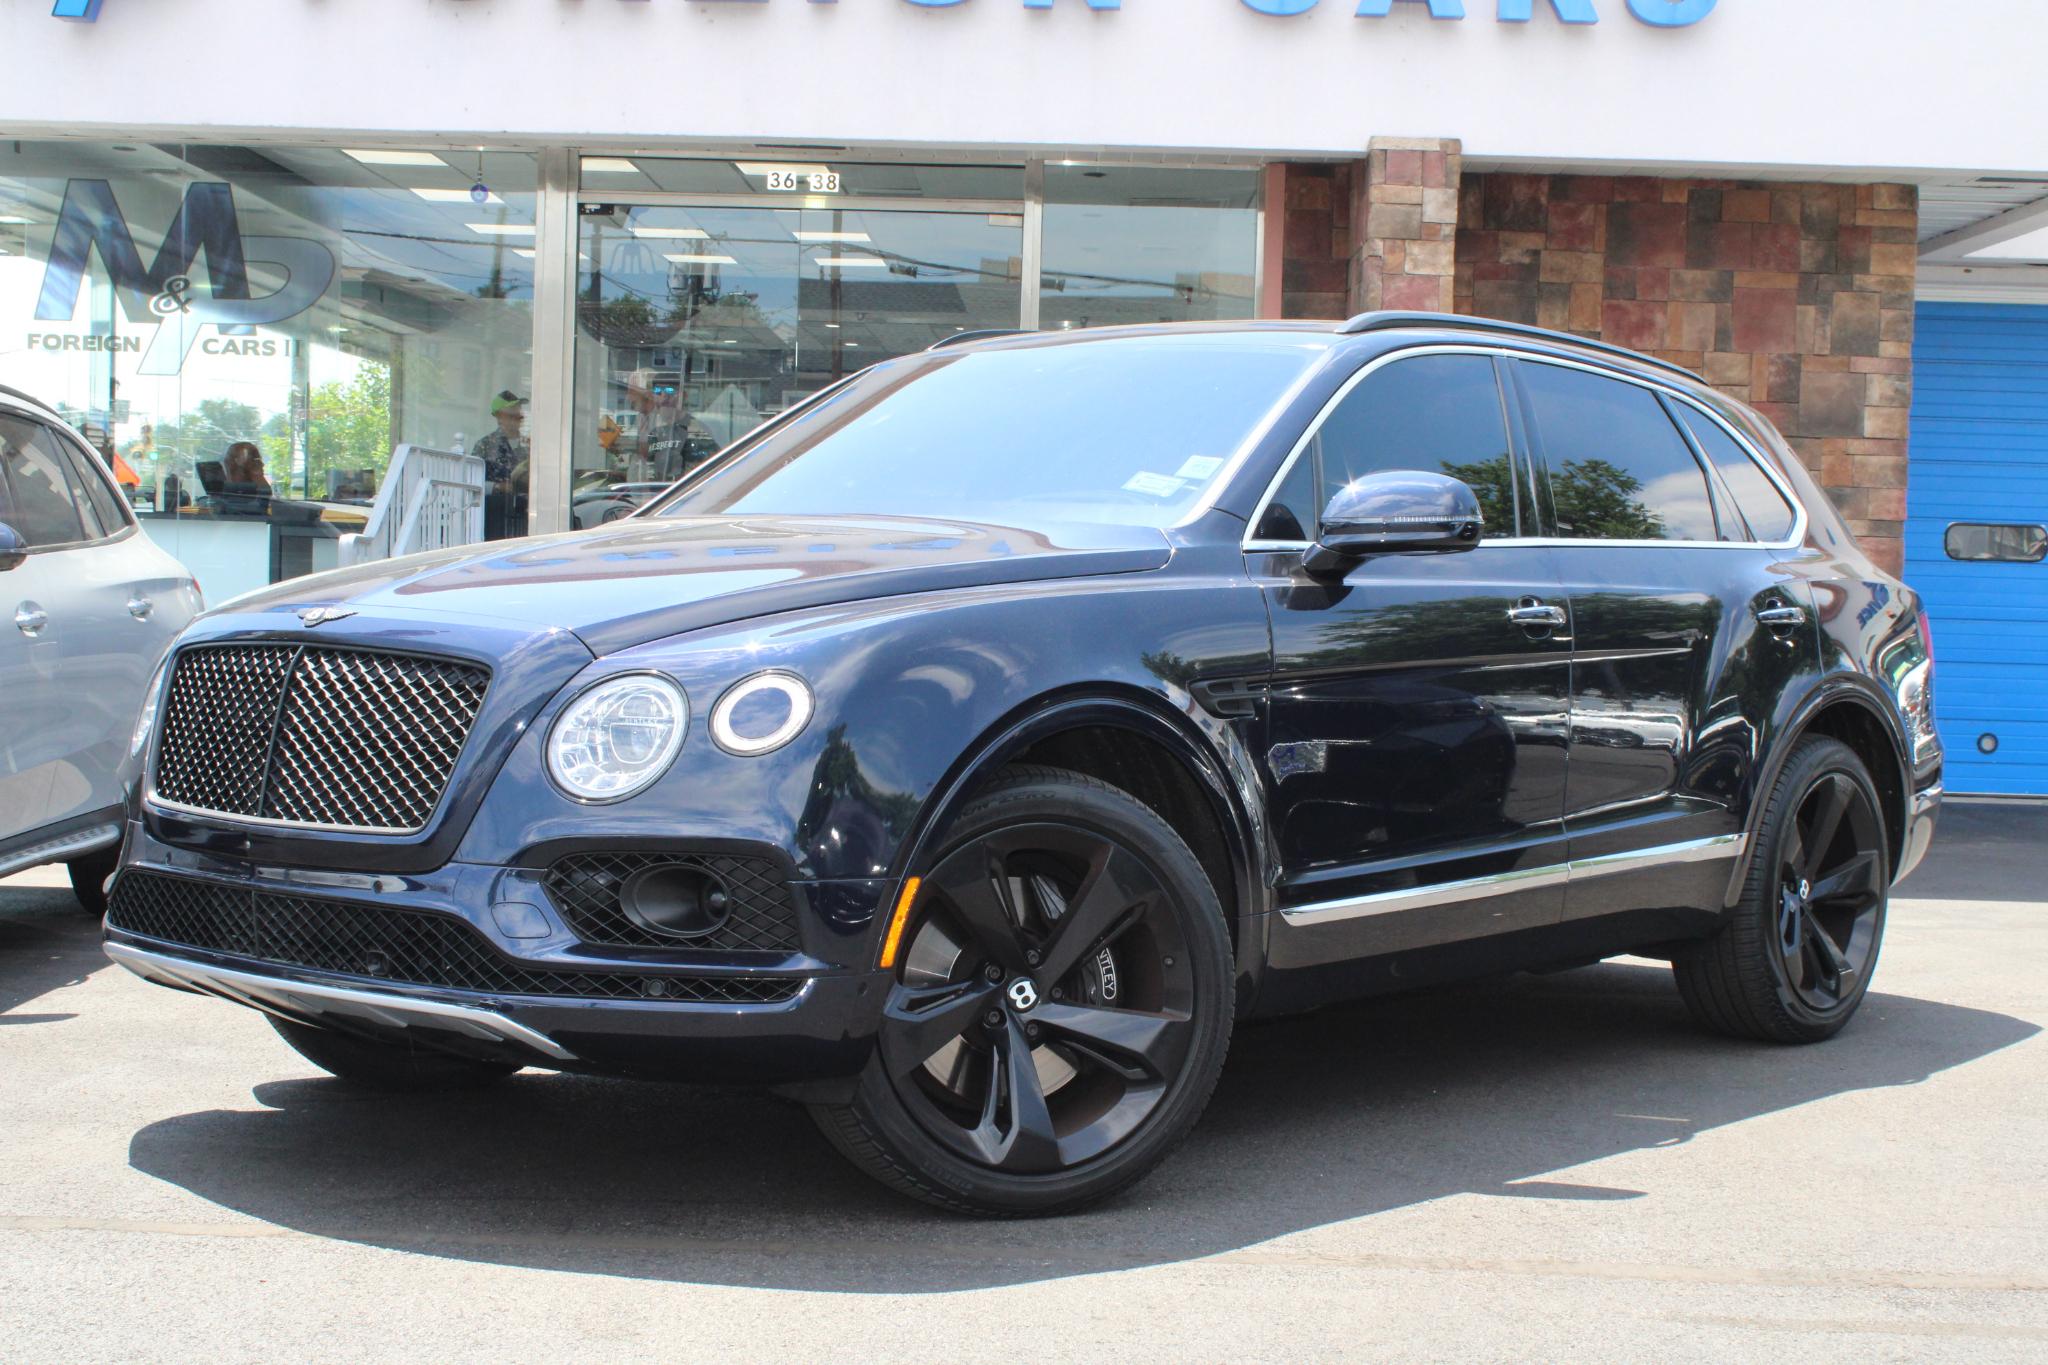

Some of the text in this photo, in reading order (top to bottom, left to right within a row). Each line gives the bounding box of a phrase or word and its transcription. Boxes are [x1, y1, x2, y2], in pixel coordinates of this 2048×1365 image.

[27, 333, 141, 353] FOREIGN
[202, 338, 277, 356] CARS
[1099, 948, 1115, 991] NTLEY
